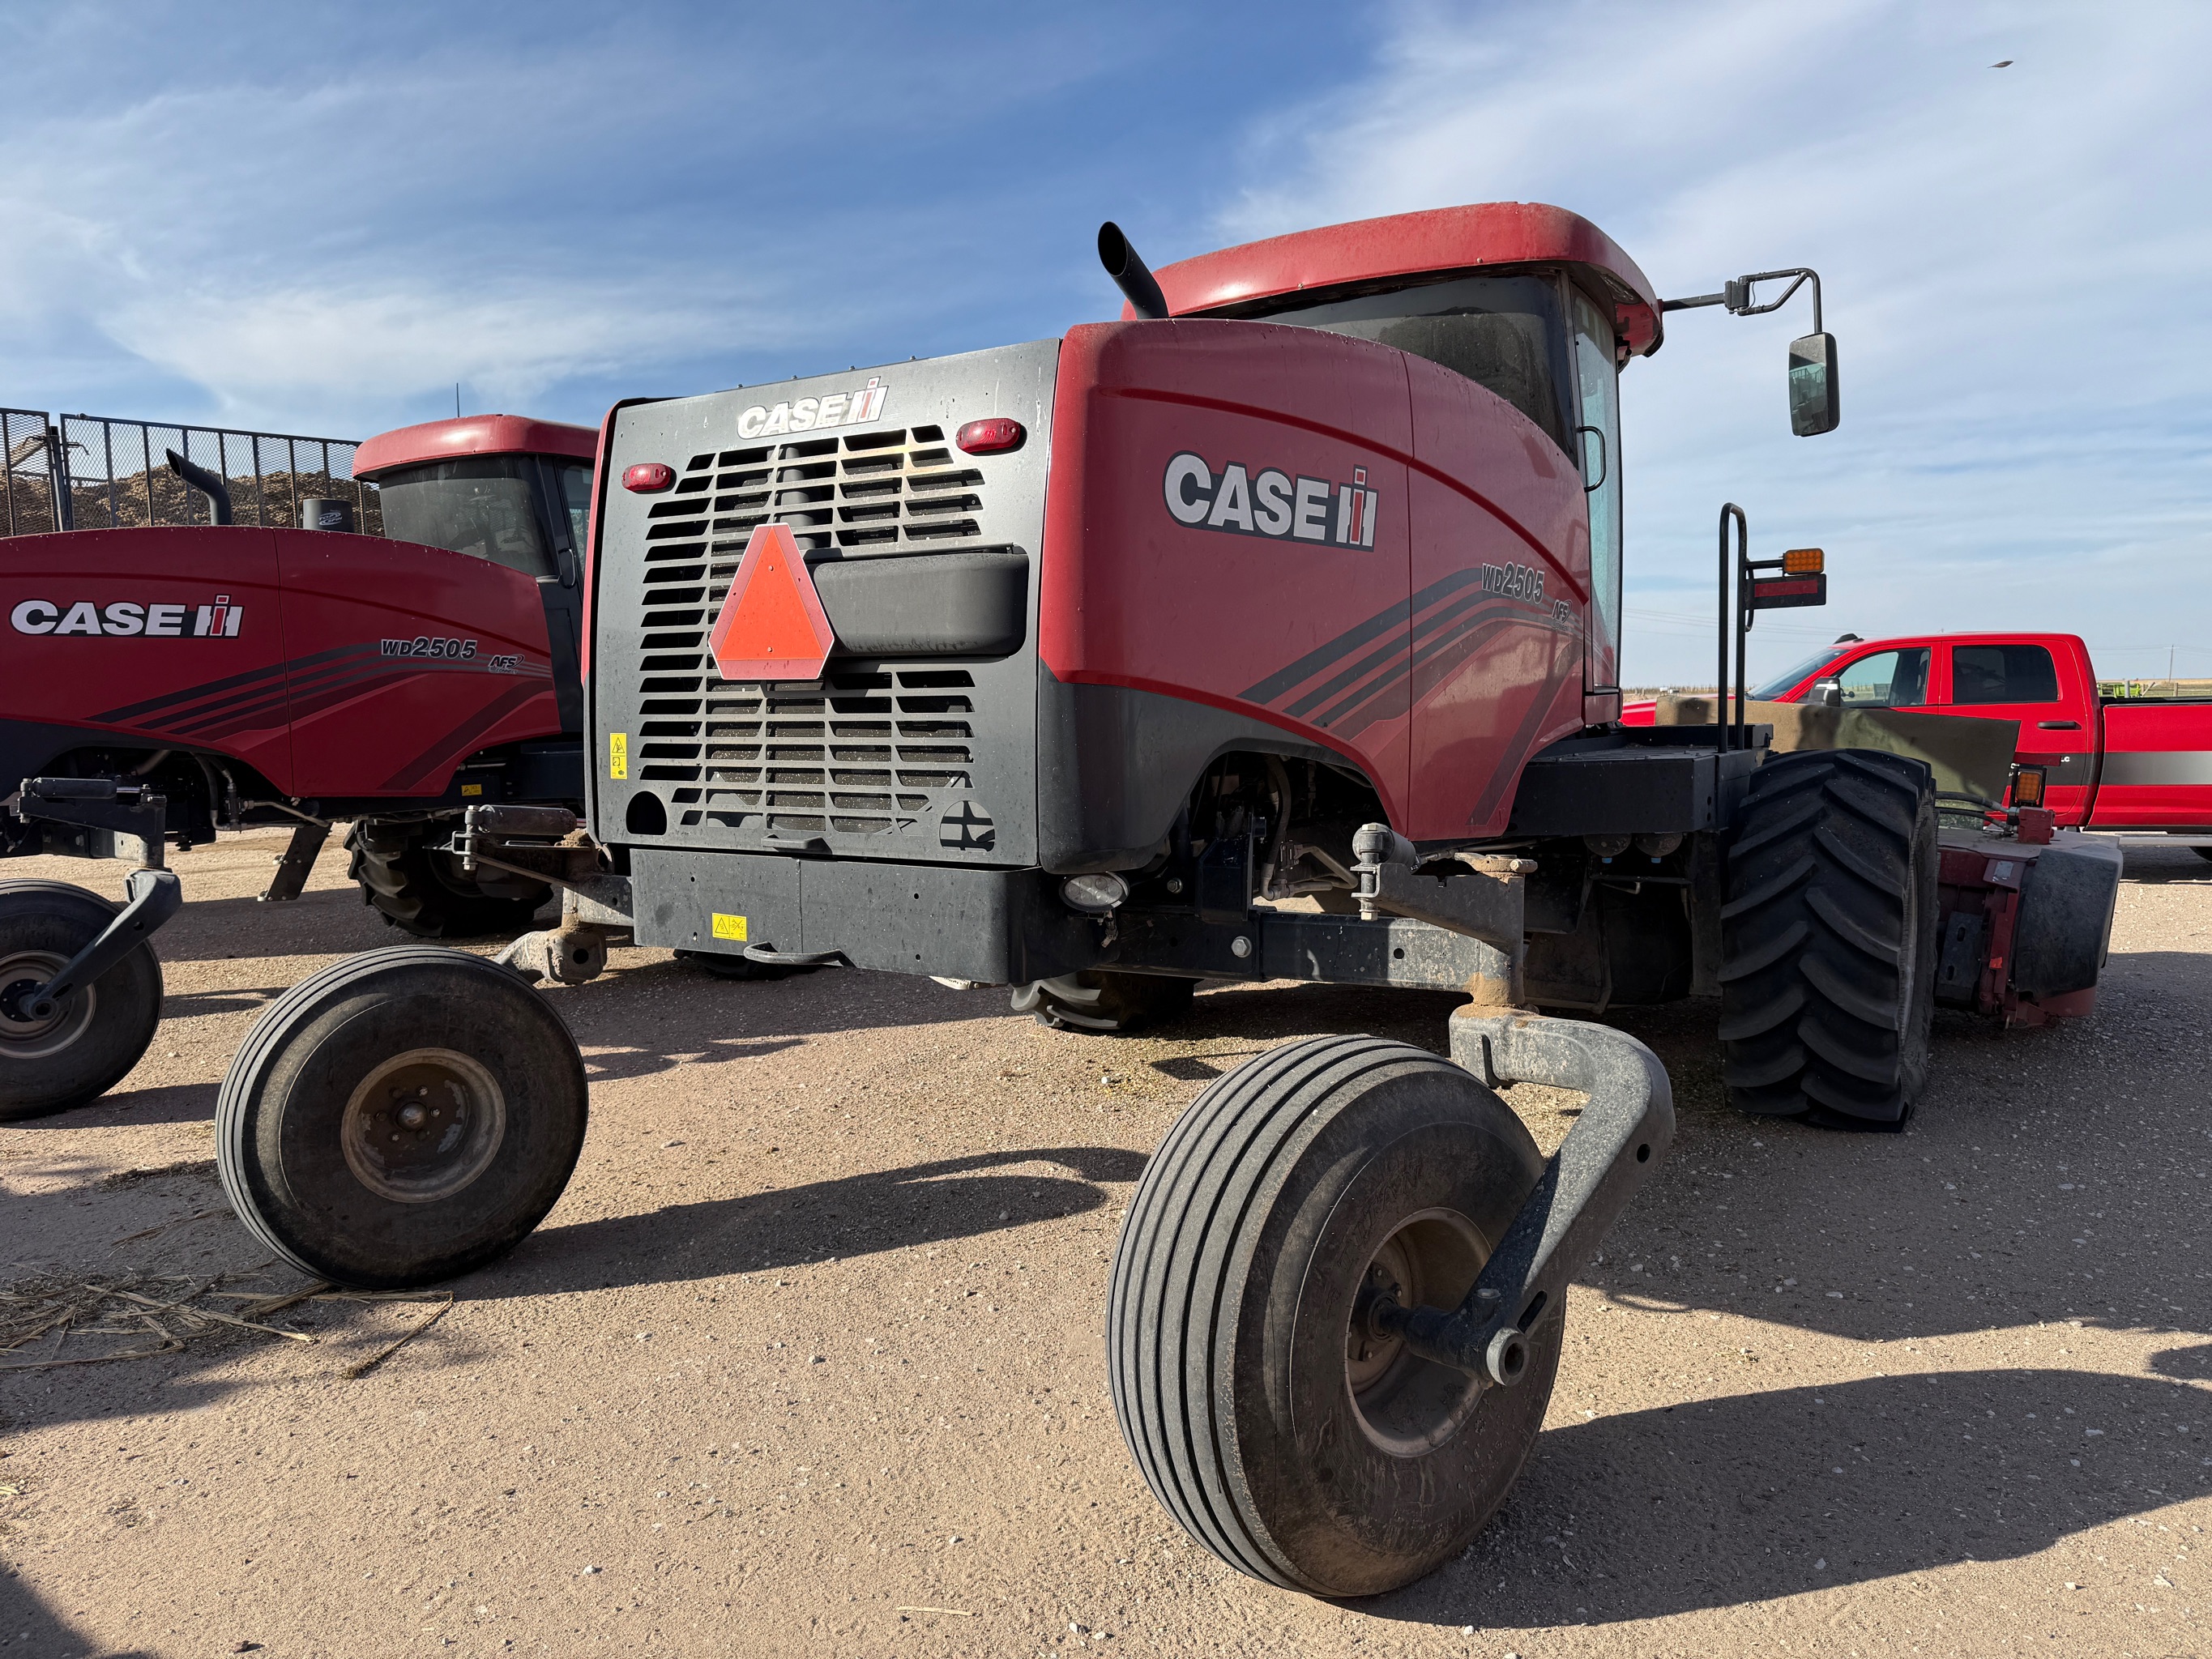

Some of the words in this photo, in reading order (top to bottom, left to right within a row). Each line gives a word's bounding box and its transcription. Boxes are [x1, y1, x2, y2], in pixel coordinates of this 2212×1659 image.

[737, 392, 848, 440] CASE
[1164, 453, 1330, 541] CASE
[1481, 561, 1545, 604] WD2505
[11, 599, 186, 635] CASE
[1551, 599, 1570, 623] AFS
[381, 636, 477, 660] WD2505
[488, 655, 518, 668] AFS
